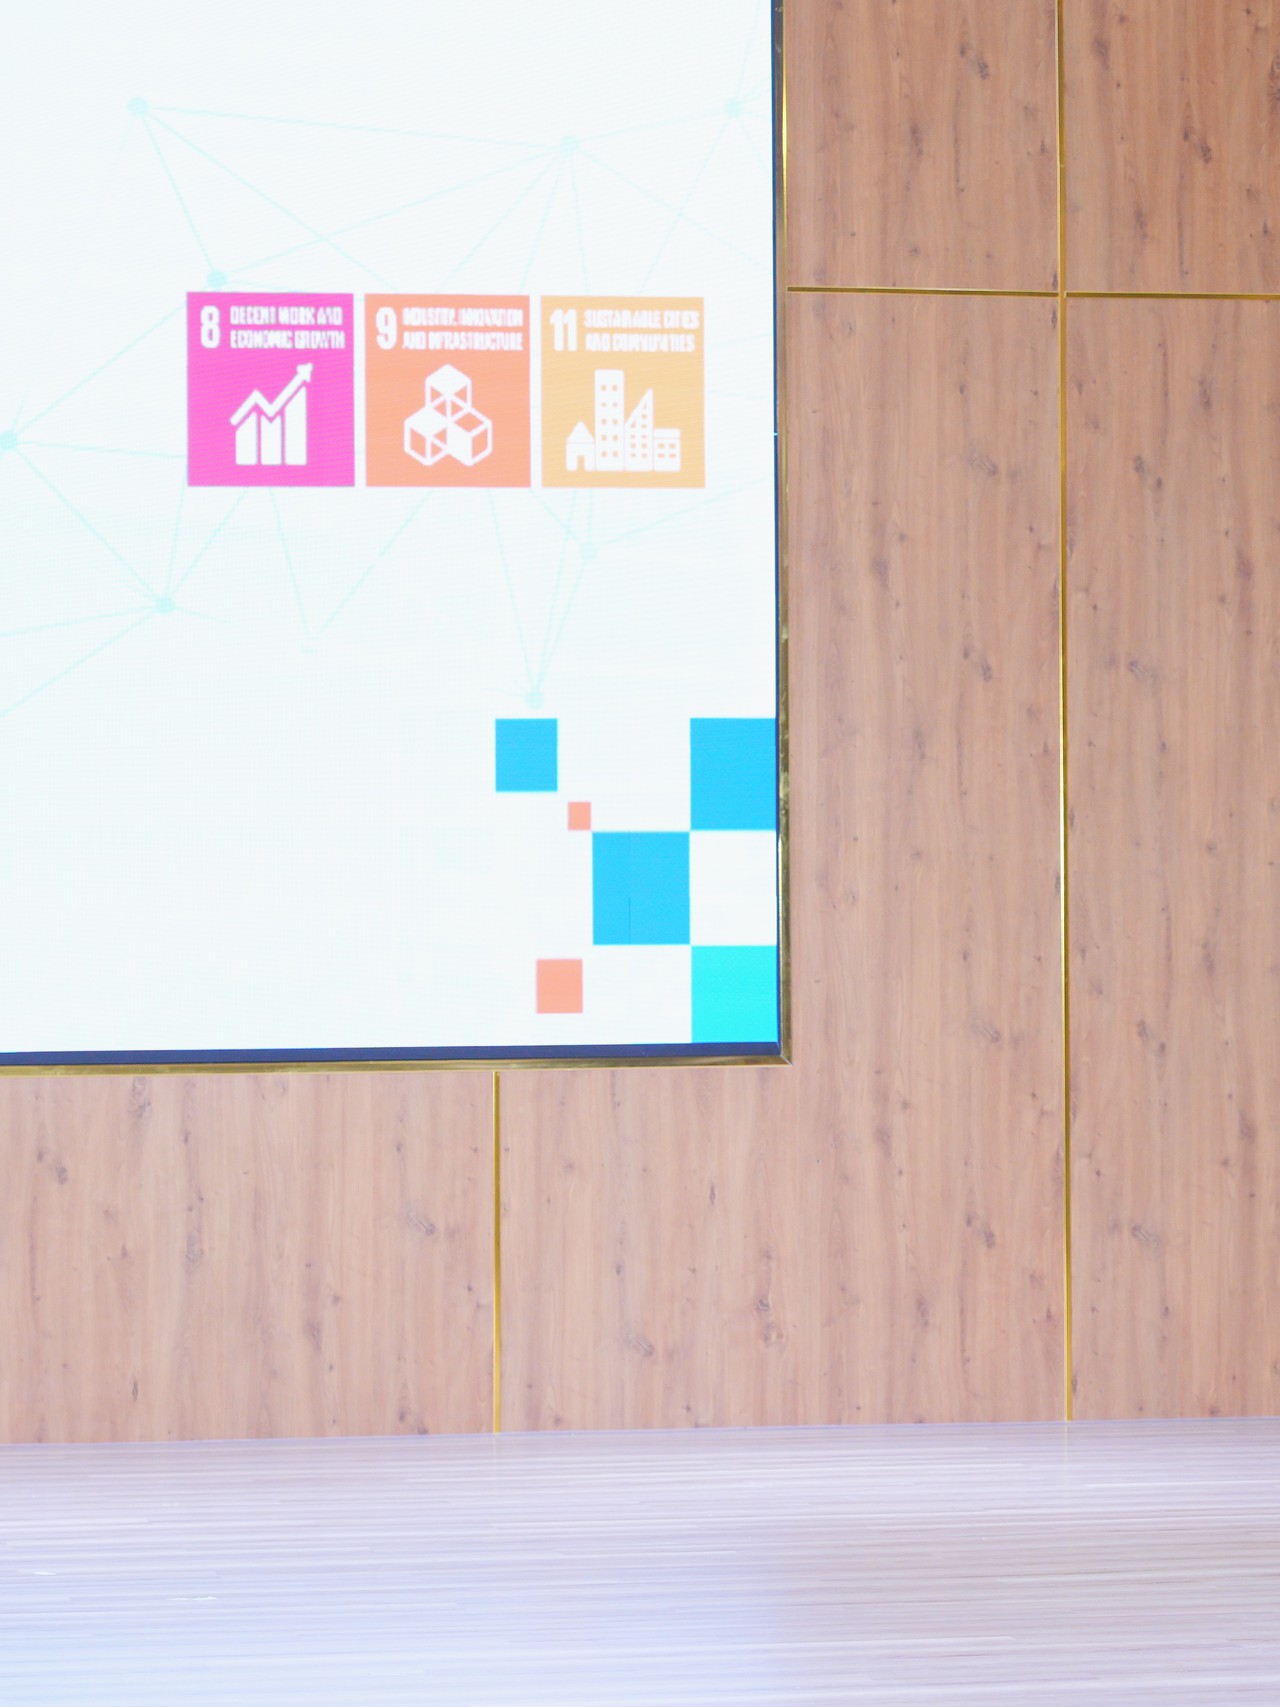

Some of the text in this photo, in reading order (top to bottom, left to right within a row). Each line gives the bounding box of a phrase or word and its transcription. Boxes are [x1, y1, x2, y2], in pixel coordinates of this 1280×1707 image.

[201, 305, 220, 349] 8
[375, 306, 397, 350] 9
[550, 308, 577, 351] 11
